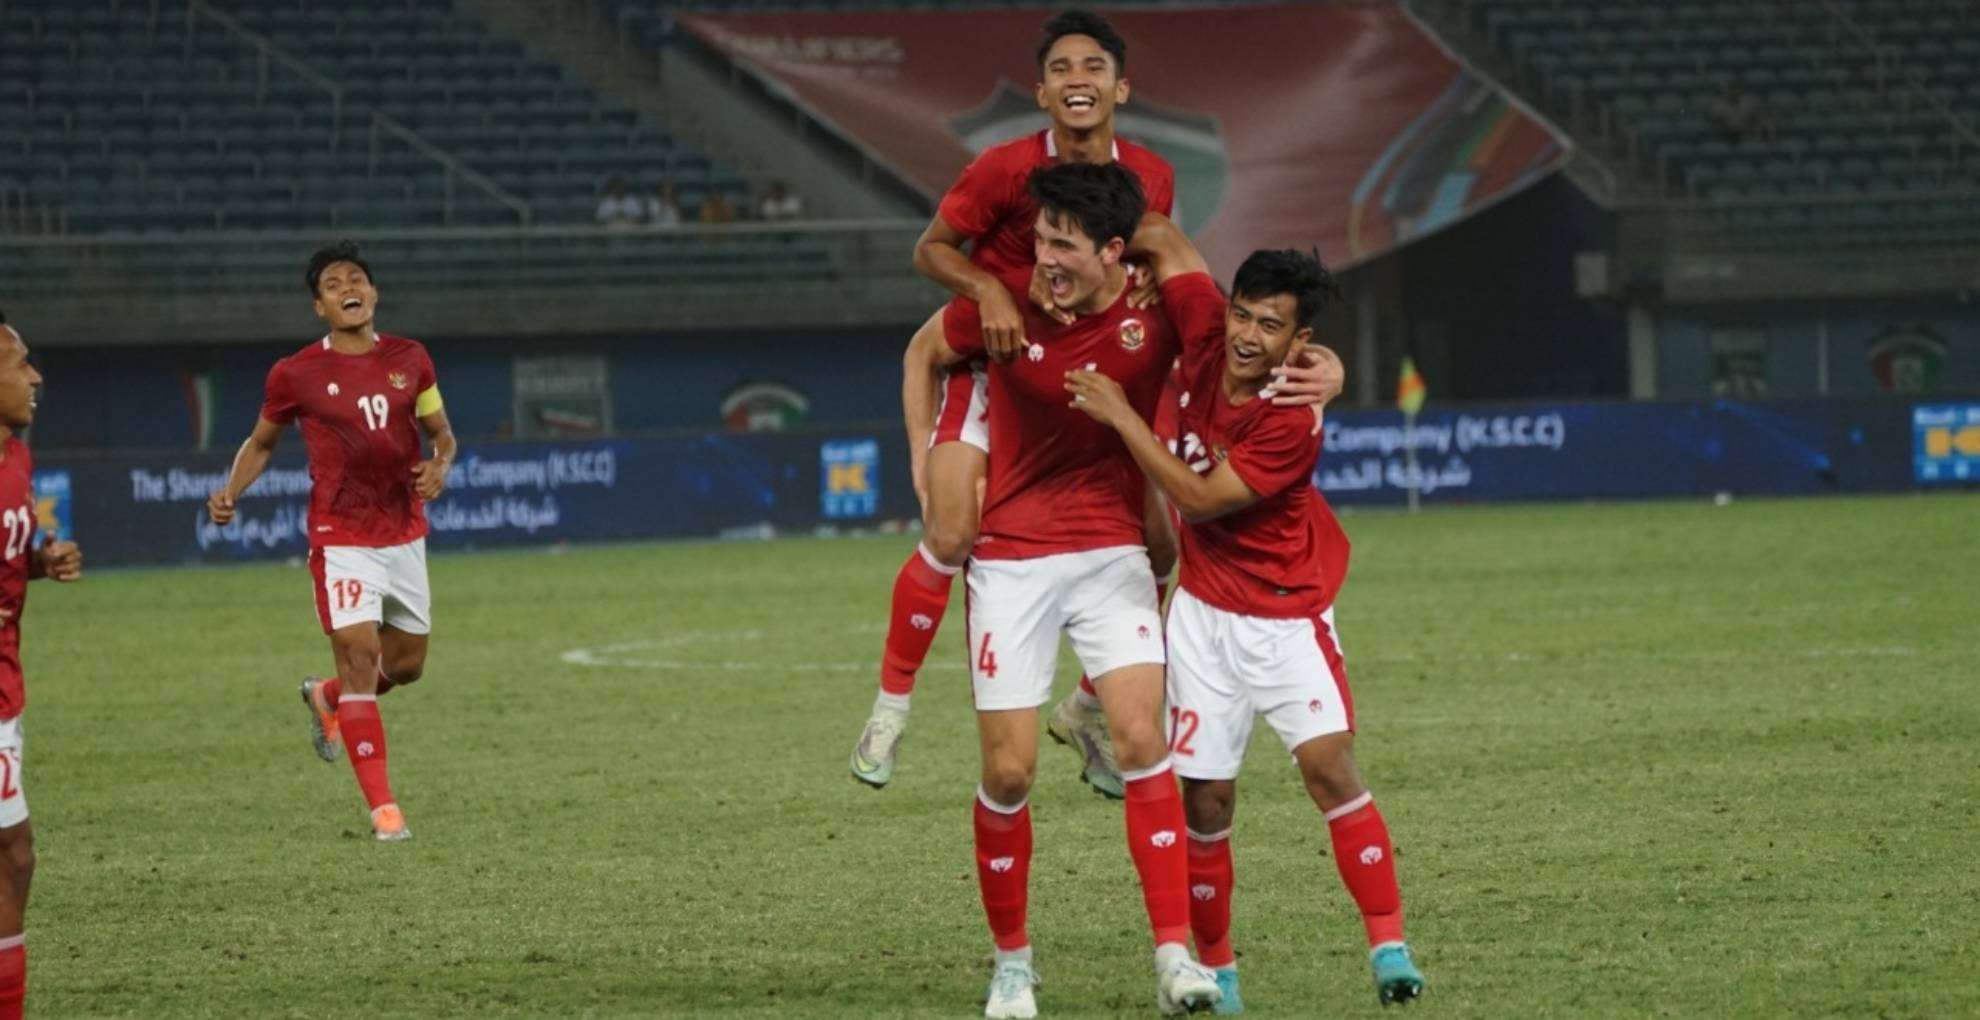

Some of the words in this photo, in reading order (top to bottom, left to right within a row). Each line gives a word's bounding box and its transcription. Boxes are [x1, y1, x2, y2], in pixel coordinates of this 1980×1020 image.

[357, 394, 389, 430] 19
[1323, 421, 1452, 456] Company
[130, 469, 164, 501] The
[468, 455, 545, 491] Company
[332, 579, 362, 608] 19
[978, 632, 997, 678] 4
[1168, 706, 1199, 756] 12
